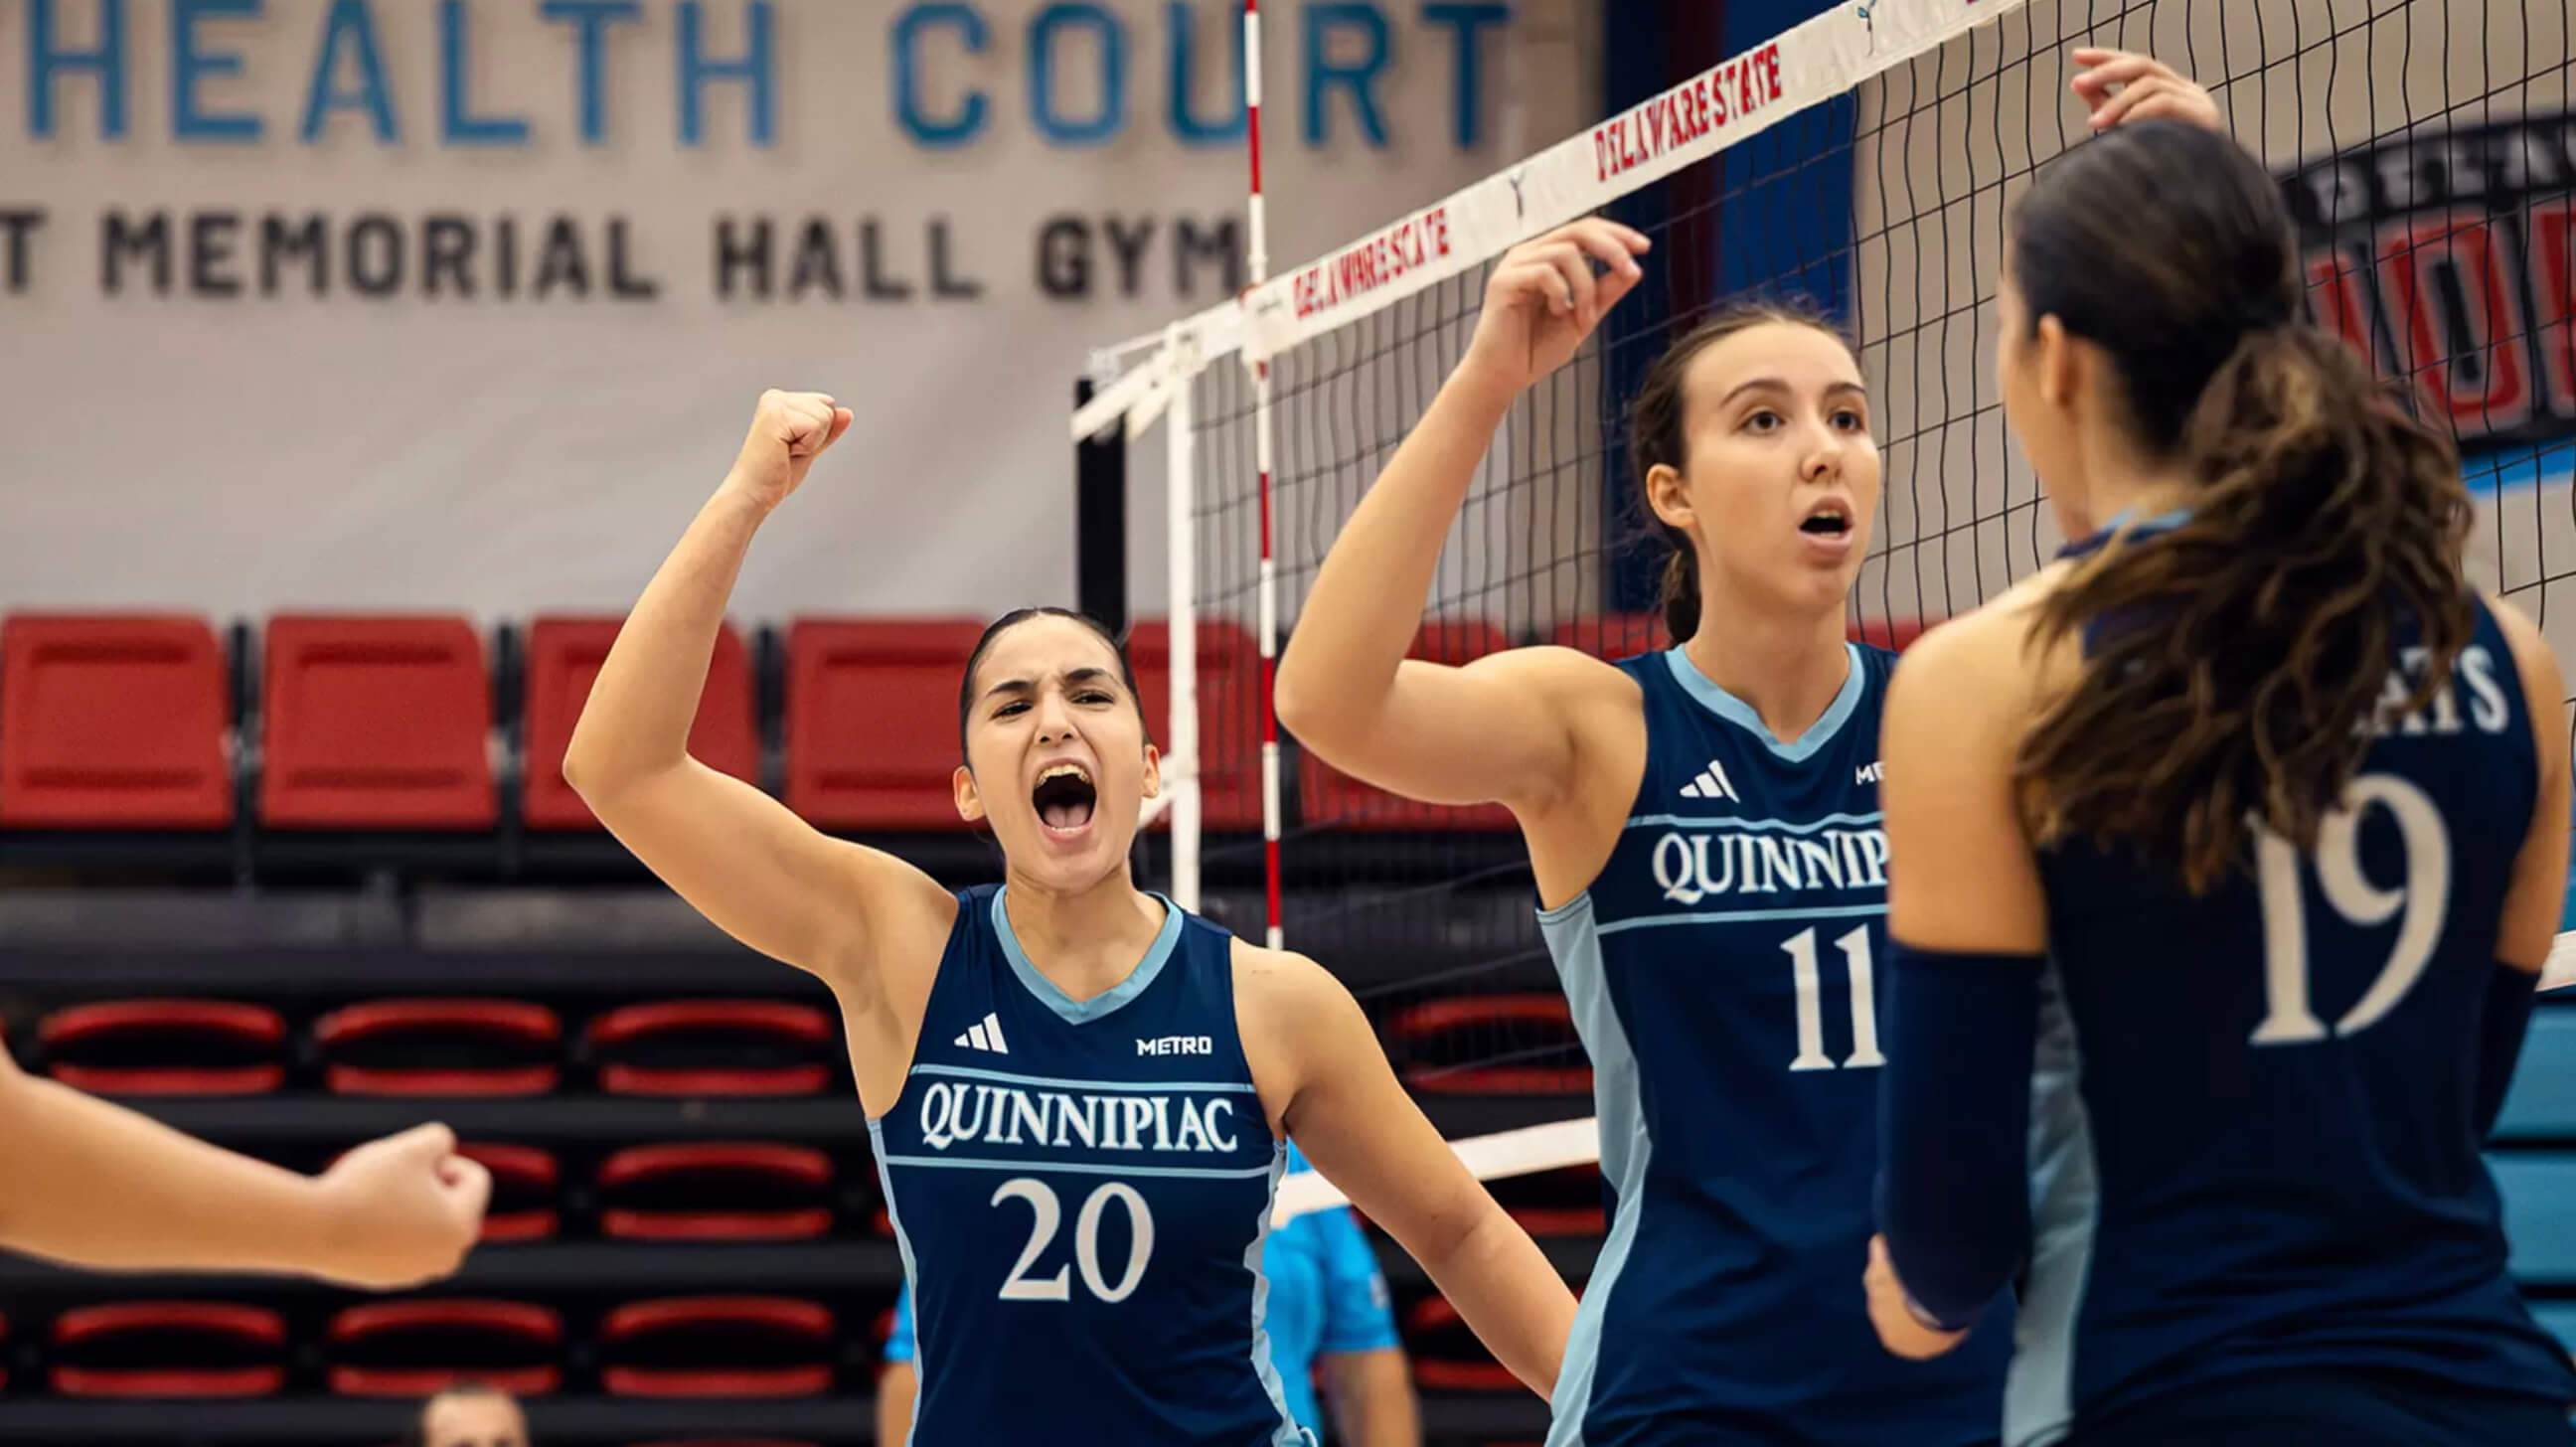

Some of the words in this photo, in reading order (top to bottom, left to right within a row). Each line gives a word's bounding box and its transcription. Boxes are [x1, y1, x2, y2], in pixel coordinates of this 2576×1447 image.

[26, 0, 777, 145] HEALTH
[891, 0, 1511, 149] COURT
[102, 209, 658, 298] MEMORIAL
[716, 215, 983, 299] HALL
[1039, 216, 1244, 299] GYM
[2244, 773, 2452, 1045] 19
[1136, 1036, 1212, 1055] METRO
[1779, 923, 1887, 1070] 11
[919, 1082, 1238, 1152] QUINNIPIAC
[990, 1178, 1155, 1304] 20
